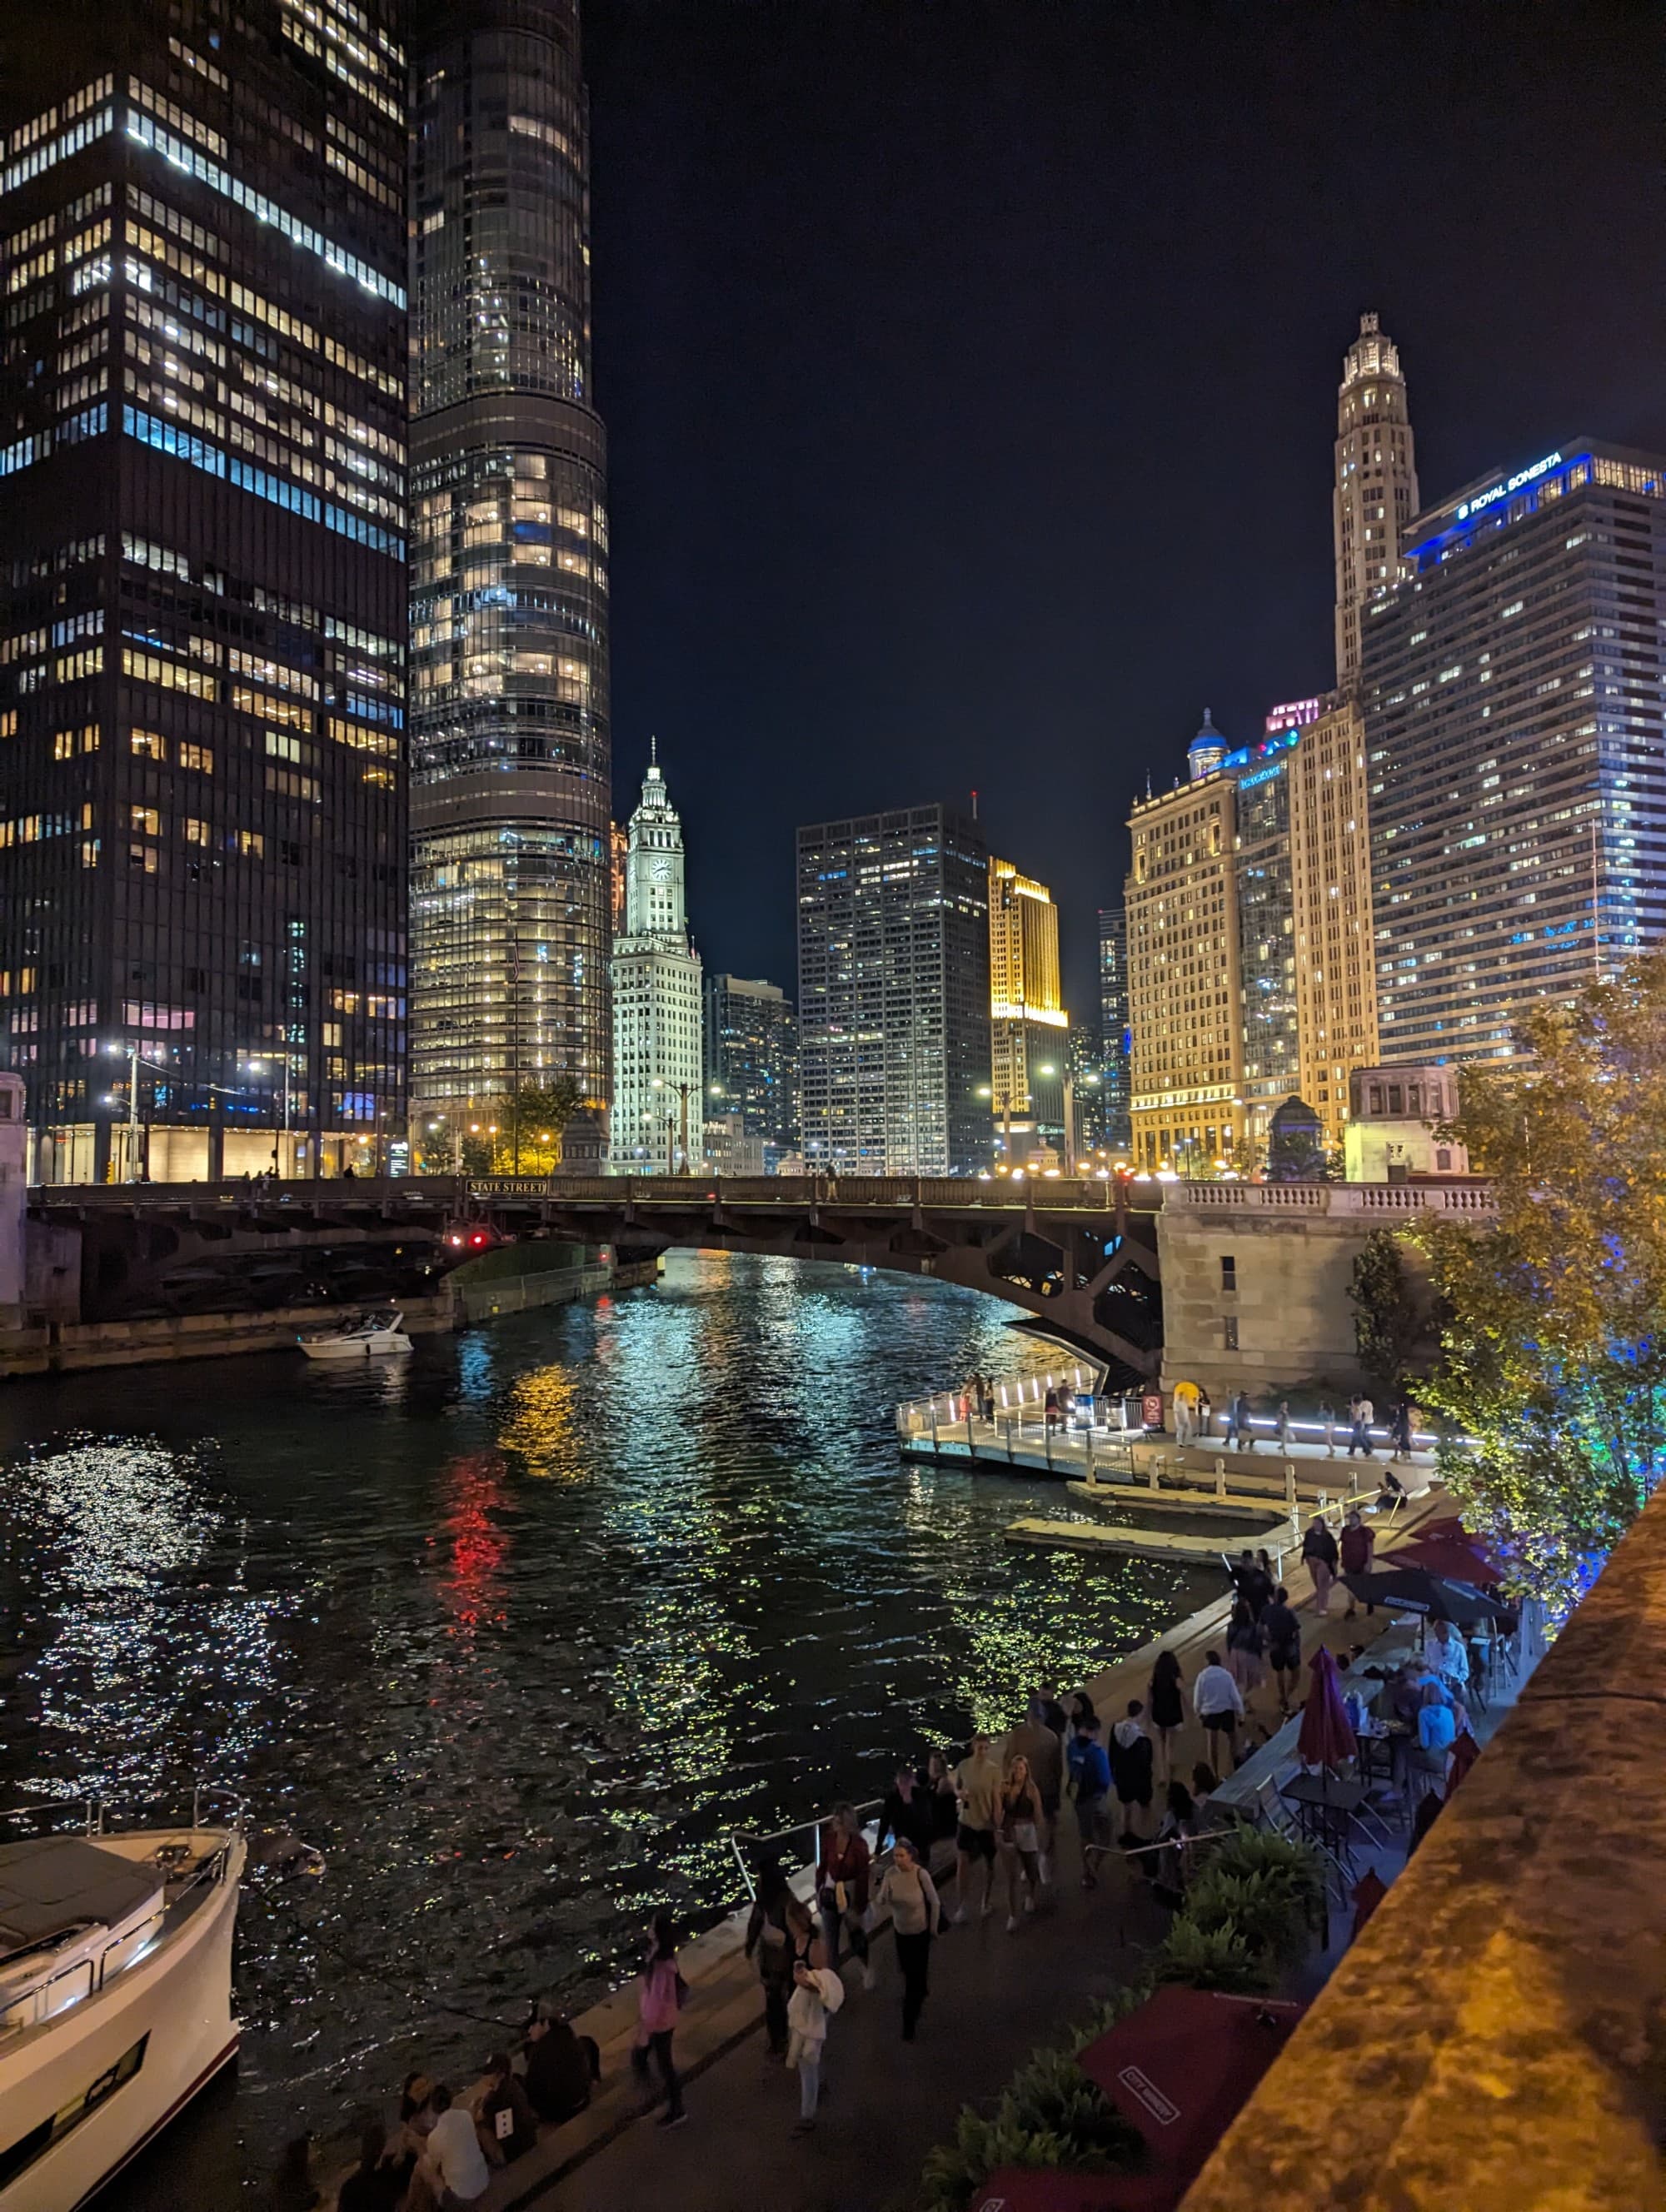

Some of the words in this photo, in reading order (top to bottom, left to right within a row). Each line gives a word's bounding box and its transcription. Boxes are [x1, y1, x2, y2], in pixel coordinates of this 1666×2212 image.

[1471, 485, 1506, 513] ROYAL
[1508, 451, 1562, 491] SONESTA
[470, 1182, 501, 1193] STATE
[503, 1182, 543, 1193] STREET
